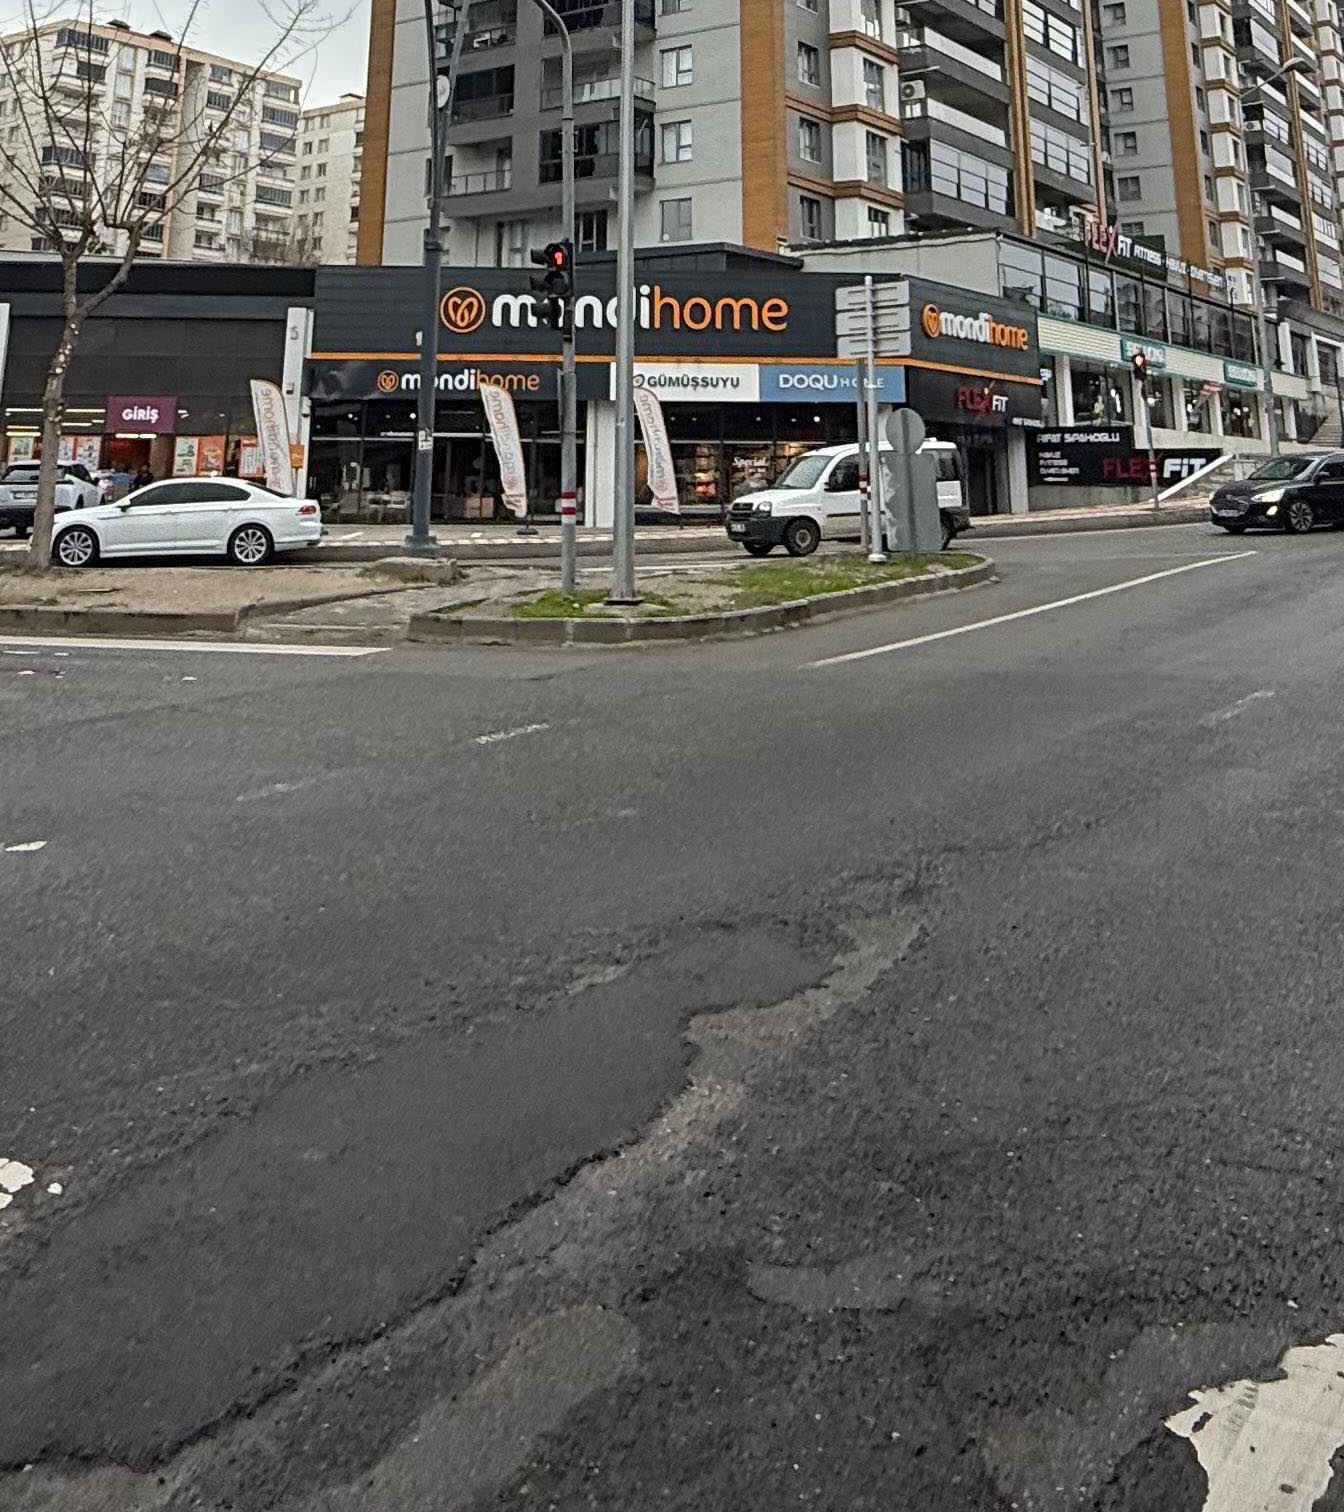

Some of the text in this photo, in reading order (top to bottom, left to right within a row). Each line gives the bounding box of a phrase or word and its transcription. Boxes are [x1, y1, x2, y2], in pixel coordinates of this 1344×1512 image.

[492, 284, 789, 330] mnihome
[940, 311, 1028, 350] mondihome
[401, 368, 540, 391] mndihome
[647, 374, 740, 391] GÜMÜŞSUYU
[779, 374, 838, 389] DOQU
[122, 405, 159, 423] GİRİŞ
